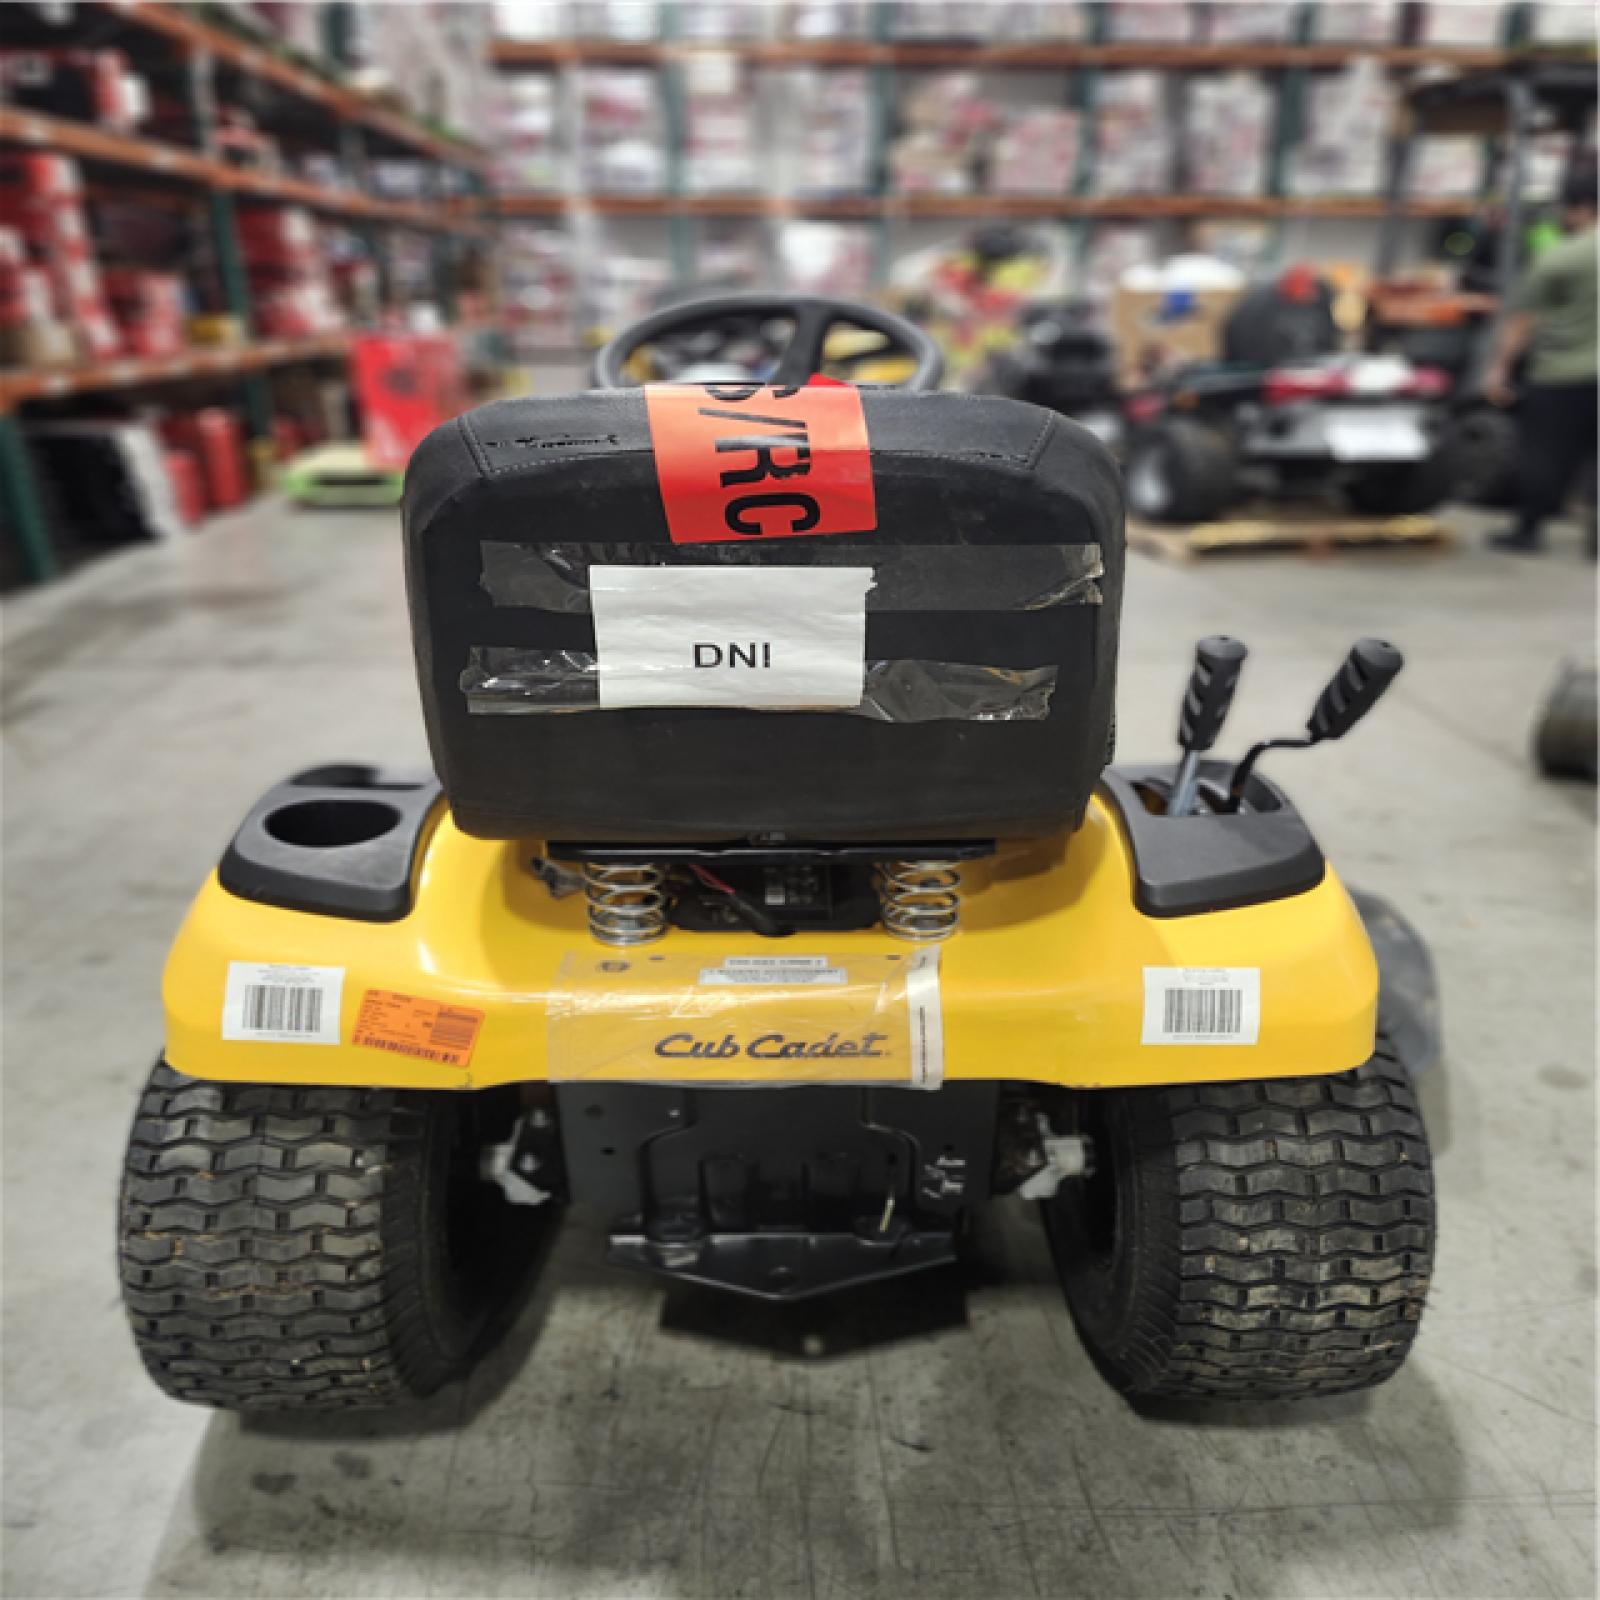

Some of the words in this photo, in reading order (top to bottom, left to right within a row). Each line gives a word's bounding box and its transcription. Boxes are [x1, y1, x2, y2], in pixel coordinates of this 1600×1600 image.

[694, 642, 770, 668] DNI
[655, 1032, 740, 1058] Cub
[747, 1032, 888, 1058] Cadet
